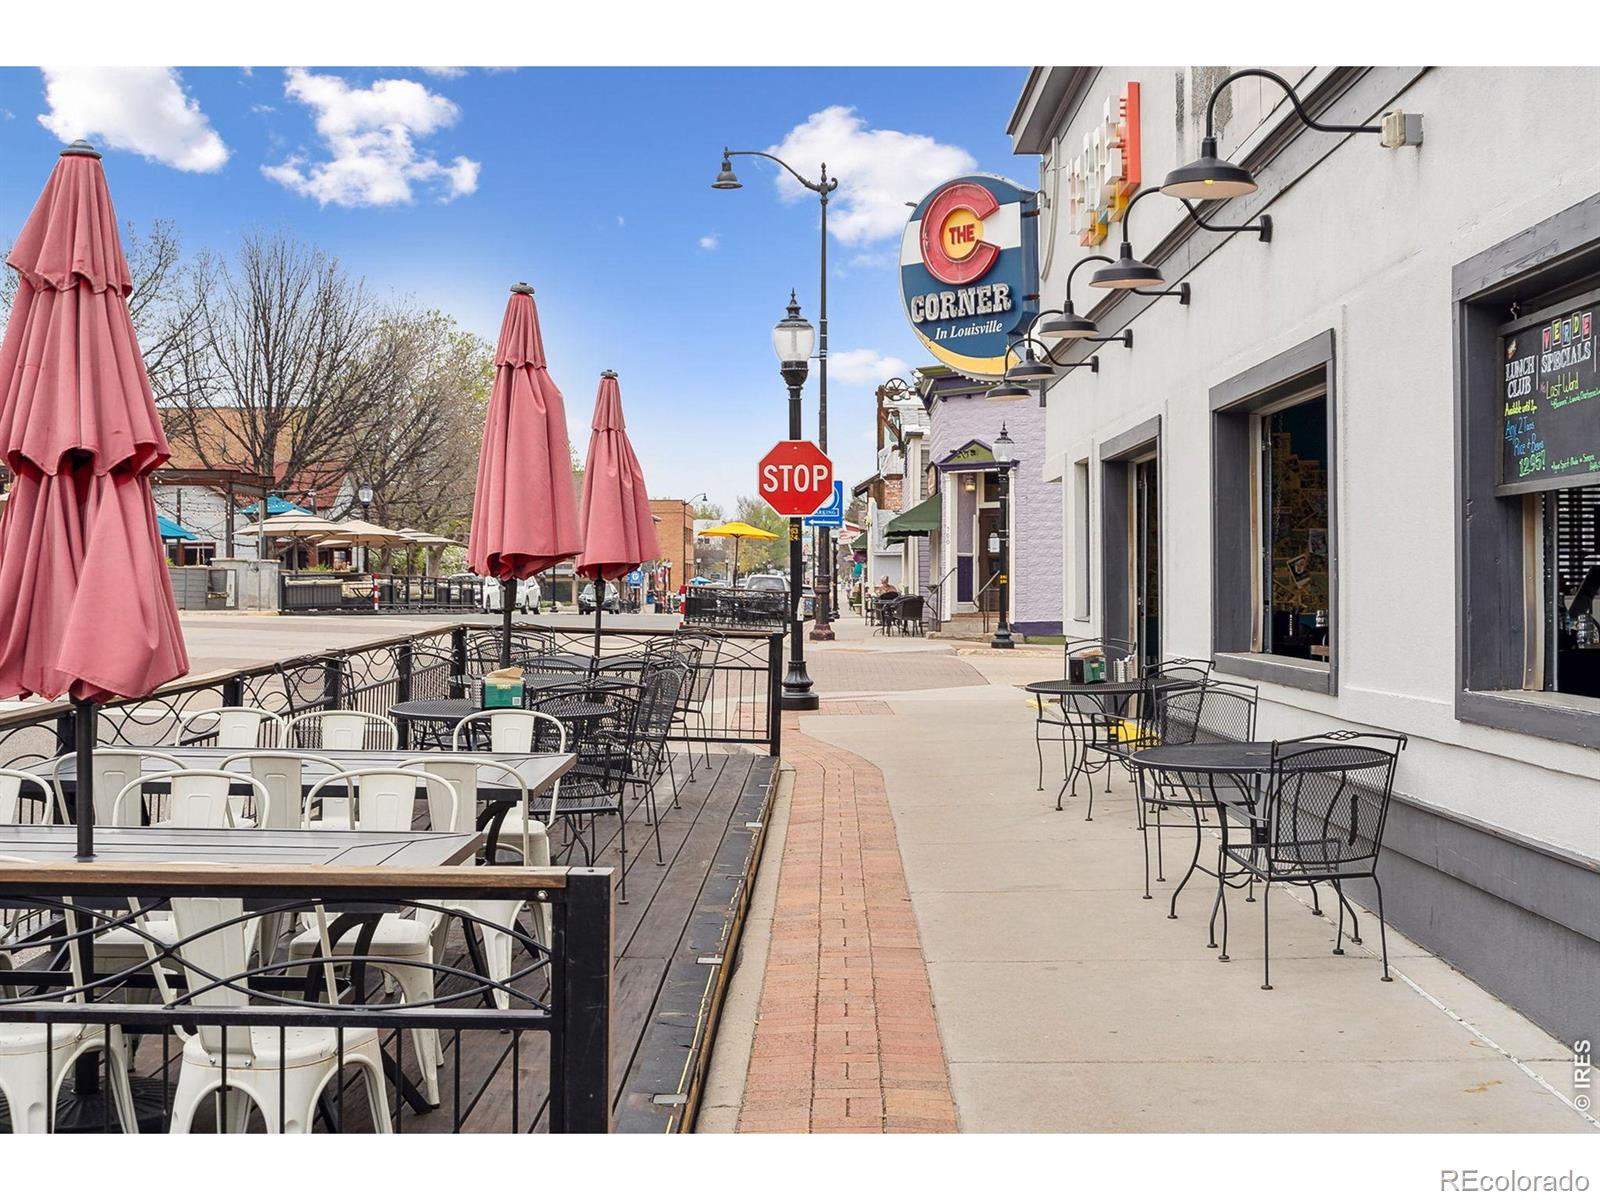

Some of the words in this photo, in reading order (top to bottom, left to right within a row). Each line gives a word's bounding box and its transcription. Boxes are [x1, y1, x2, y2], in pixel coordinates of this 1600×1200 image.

[949, 223, 975, 245] THE
[911, 283, 1012, 323] CORNER
[935, 327, 947, 340] In
[949, 320, 1003, 338] Louisville
[1543, 313, 1591, 352] VERDE
[1505, 355, 1535, 382] LUNCH
[1541, 341, 1592, 373] SPECIALS
[1507, 376, 1531, 399] CLUB
[1517, 416, 1524, 434] 2
[763, 464, 828, 493] STOP
